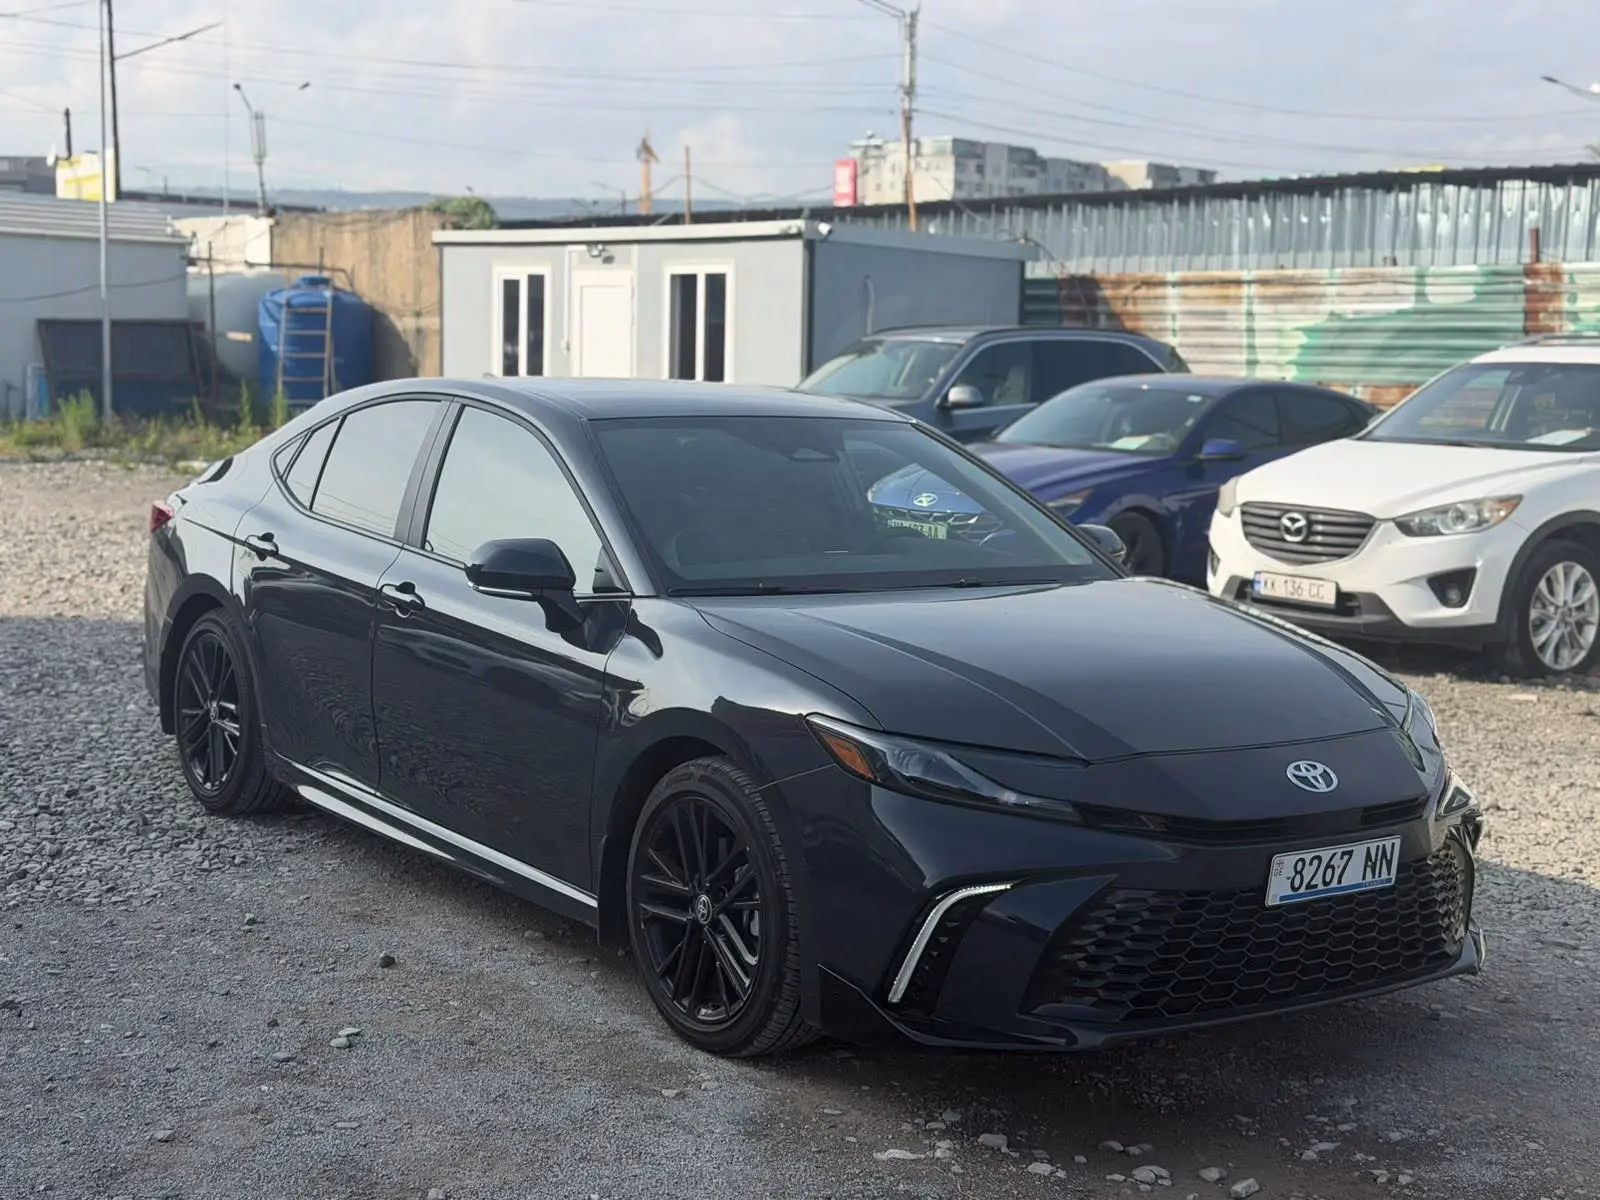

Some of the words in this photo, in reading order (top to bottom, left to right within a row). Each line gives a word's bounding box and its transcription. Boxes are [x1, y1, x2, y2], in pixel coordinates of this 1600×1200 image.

[1284, 579, 1303, 597] 136
[1308, 582, 1325, 599] CC
[1290, 849, 1354, 892] 8267
[1362, 842, 1396, 881] NN
